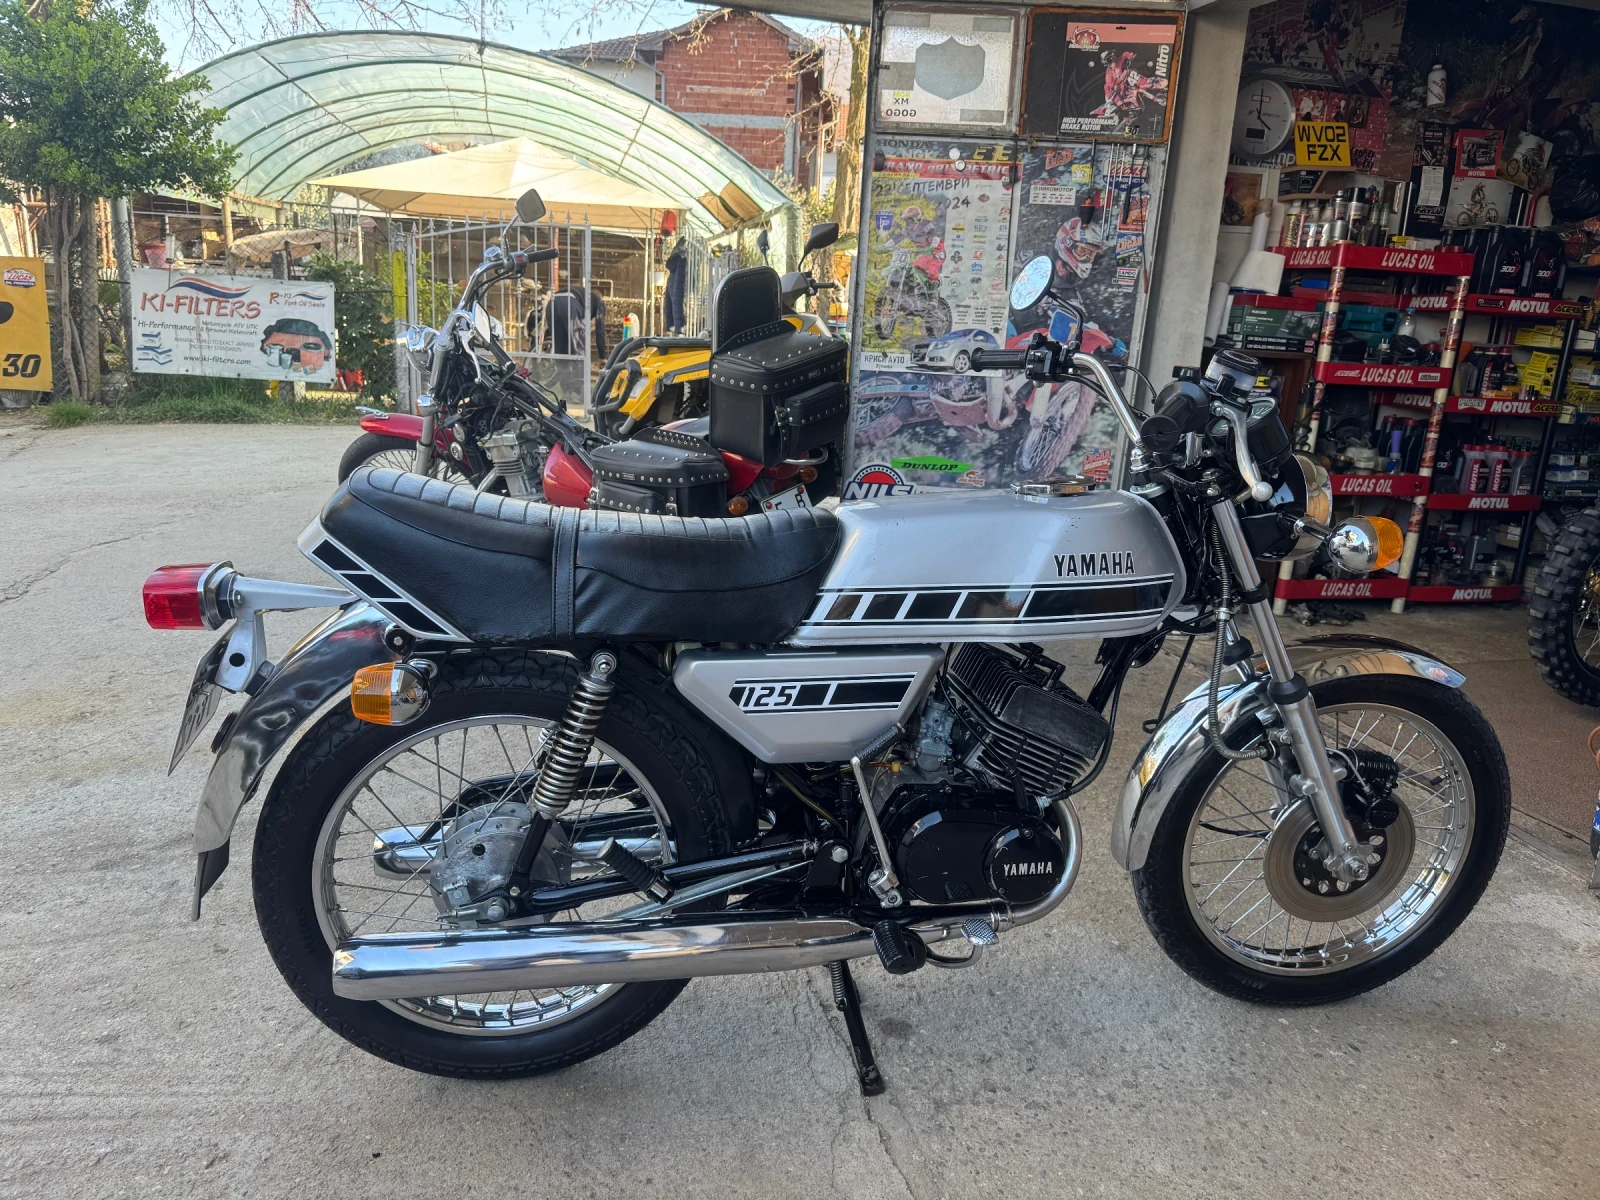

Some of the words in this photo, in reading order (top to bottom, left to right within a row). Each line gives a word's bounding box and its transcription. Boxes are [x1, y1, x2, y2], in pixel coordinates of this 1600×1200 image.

[1155, 44, 1170, 77] Nitro
[1077, 118, 1119, 126] PERFORMANCE
[1298, 125, 1346, 143] WV02
[876, 140, 933, 149] HONDA
[900, 149, 934, 159] NGK
[1307, 145, 1342, 162] FZX
[884, 162, 923, 172] RAND
[1289, 250, 1318, 266] LUCAS
[1317, 250, 1331, 266] OIL
[1381, 251, 1418, 269] LUCAS
[1418, 253, 1435, 271] OIL
[8, 273, 34, 281] LUCAS
[140, 291, 261, 320] KI-FILTERS
[1409, 296, 1449, 309] MOTUL
[1507, 300, 1550, 314] MOTUL
[137, 320, 197, 332] Hi-Performance
[201, 320, 232, 329] Motorcycle
[228, 328, 259, 336] Watercraft
[174, 336, 212, 345] MANUFACTURED
[2, 354, 42, 378] 30
[888, 355, 906, 364] АУТО
[1360, 367, 1396, 383] LUCAS
[1396, 369, 1414, 384] OIL
[1481, 364, 1492, 392] MOTUL
[1393, 393, 1433, 408] MOTUL
[1489, 400, 1532, 415] MOTUL
[901, 461, 959, 471] DUNLOP
[1340, 477, 1376, 493] LUCAS
[1375, 479, 1392, 493] OIL
[1469, 463, 1480, 492] MOTUL
[1492, 463, 1503, 492] MOTUL
[1468, 497, 1510, 510] MOTUL
[1053, 551, 1135, 577] YAMAHA
[1320, 582, 1352, 597] LUCAS
[1352, 584, 1372, 597] OIL
[1452, 588, 1493, 601] MOTUL
[743, 685, 797, 708] 125
[1004, 862, 1053, 877] YAMAHA
